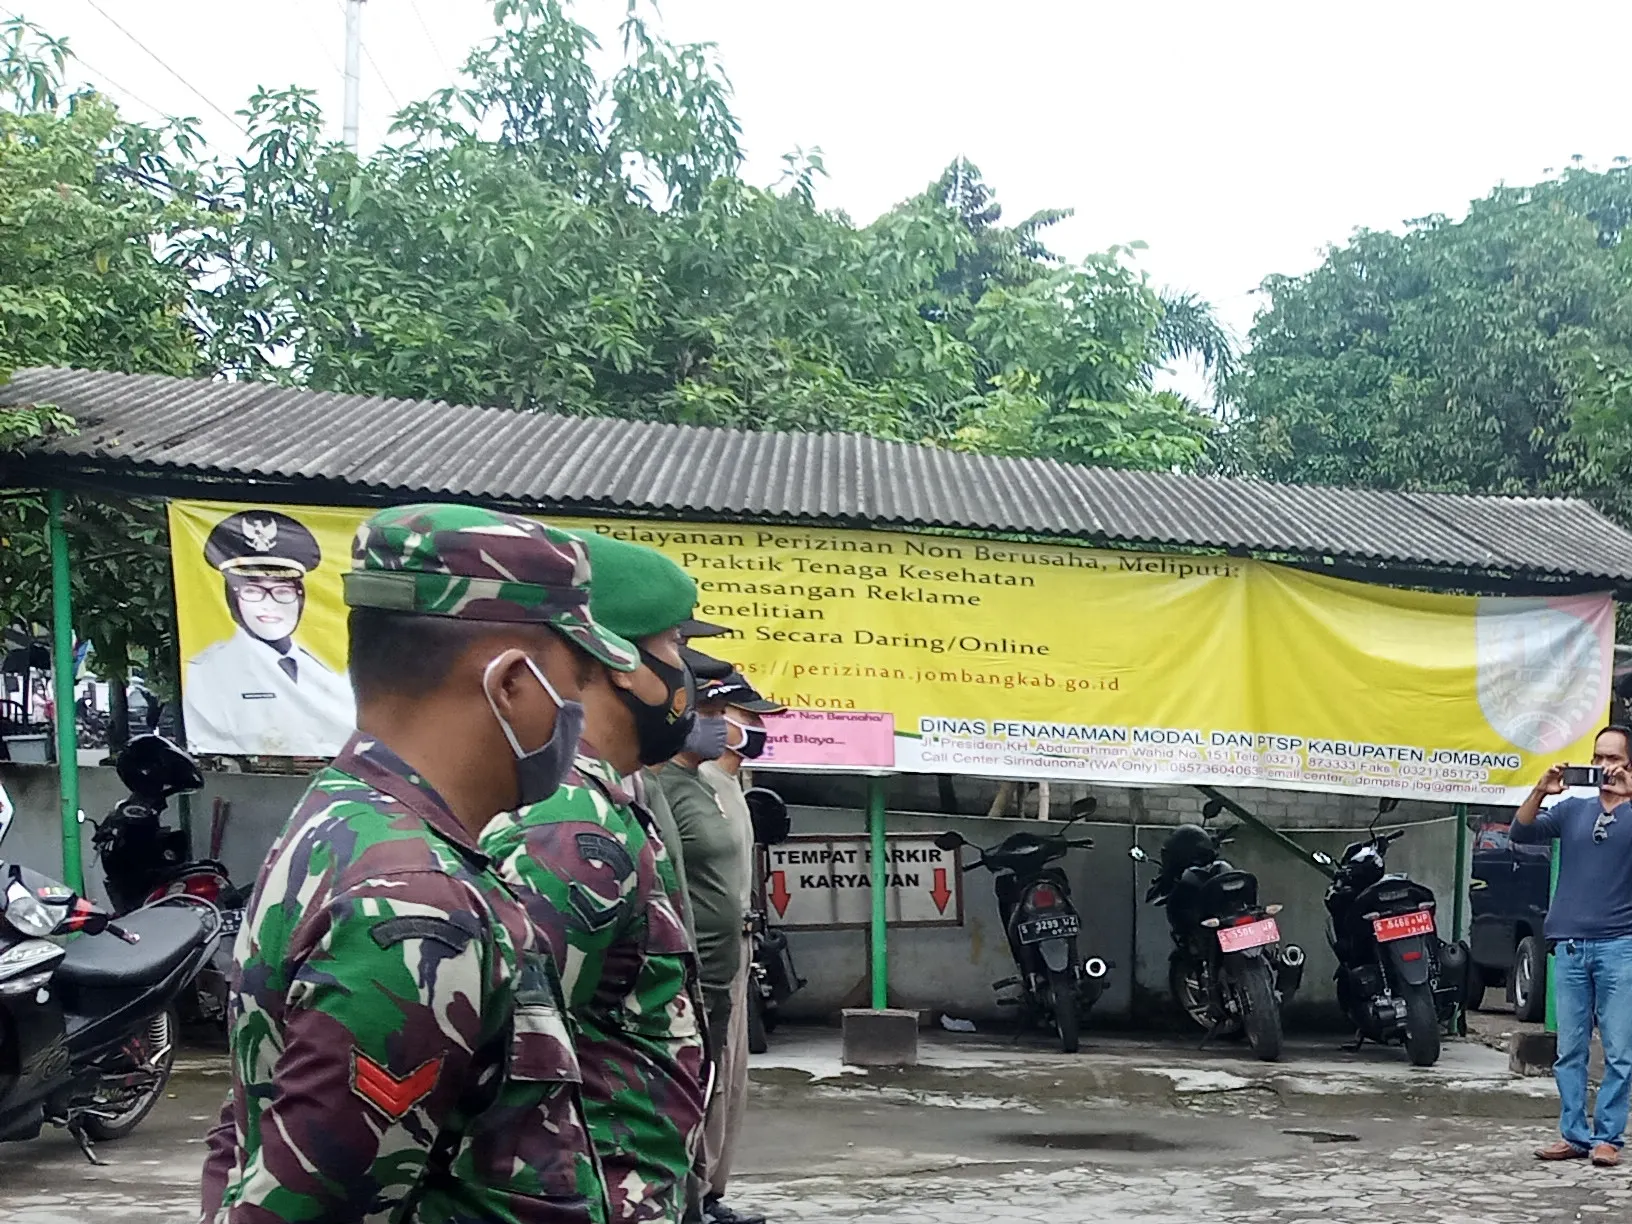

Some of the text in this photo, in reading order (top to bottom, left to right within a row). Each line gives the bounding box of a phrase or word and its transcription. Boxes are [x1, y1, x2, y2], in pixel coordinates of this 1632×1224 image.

[594, 525, 1240, 580] Pelayanan Perizinan Non Berusaha, Meliputi:
[682, 553, 1035, 587] Praktik Tenaga Kesehatan
[867, 585, 981, 606] Reklame
[756, 626, 843, 645] Secara
[855, 630, 1050, 655] Daring/Online
[733, 661, 1120, 693] ps://perizinan.jombangkab.go.id
[921, 719, 1519, 768] DINAS PENANAMAN MODAL DAN PTSP KABUPATEN JOMBANG
[922, 751, 947, 762] Call
[953, 752, 999, 764] Center
[1004, 755, 1085, 769] Sirindunona
[1090, 759, 1118, 770] (WA
[1121, 760, 1158, 774] Only)
[1268, 769, 1300, 779] email
[1036, 743, 1127, 757] Abdurrahman
[1133, 747, 1174, 758] Wahid
[1207, 750, 1228, 760] 151
[1308, 757, 1355, 770] 873333
[1398, 765, 1438, 779] (0321)
[1442, 768, 1487, 781] 851733
[773, 850, 858, 865] TEMPAT
[800, 873, 919, 889] KARYAAN
